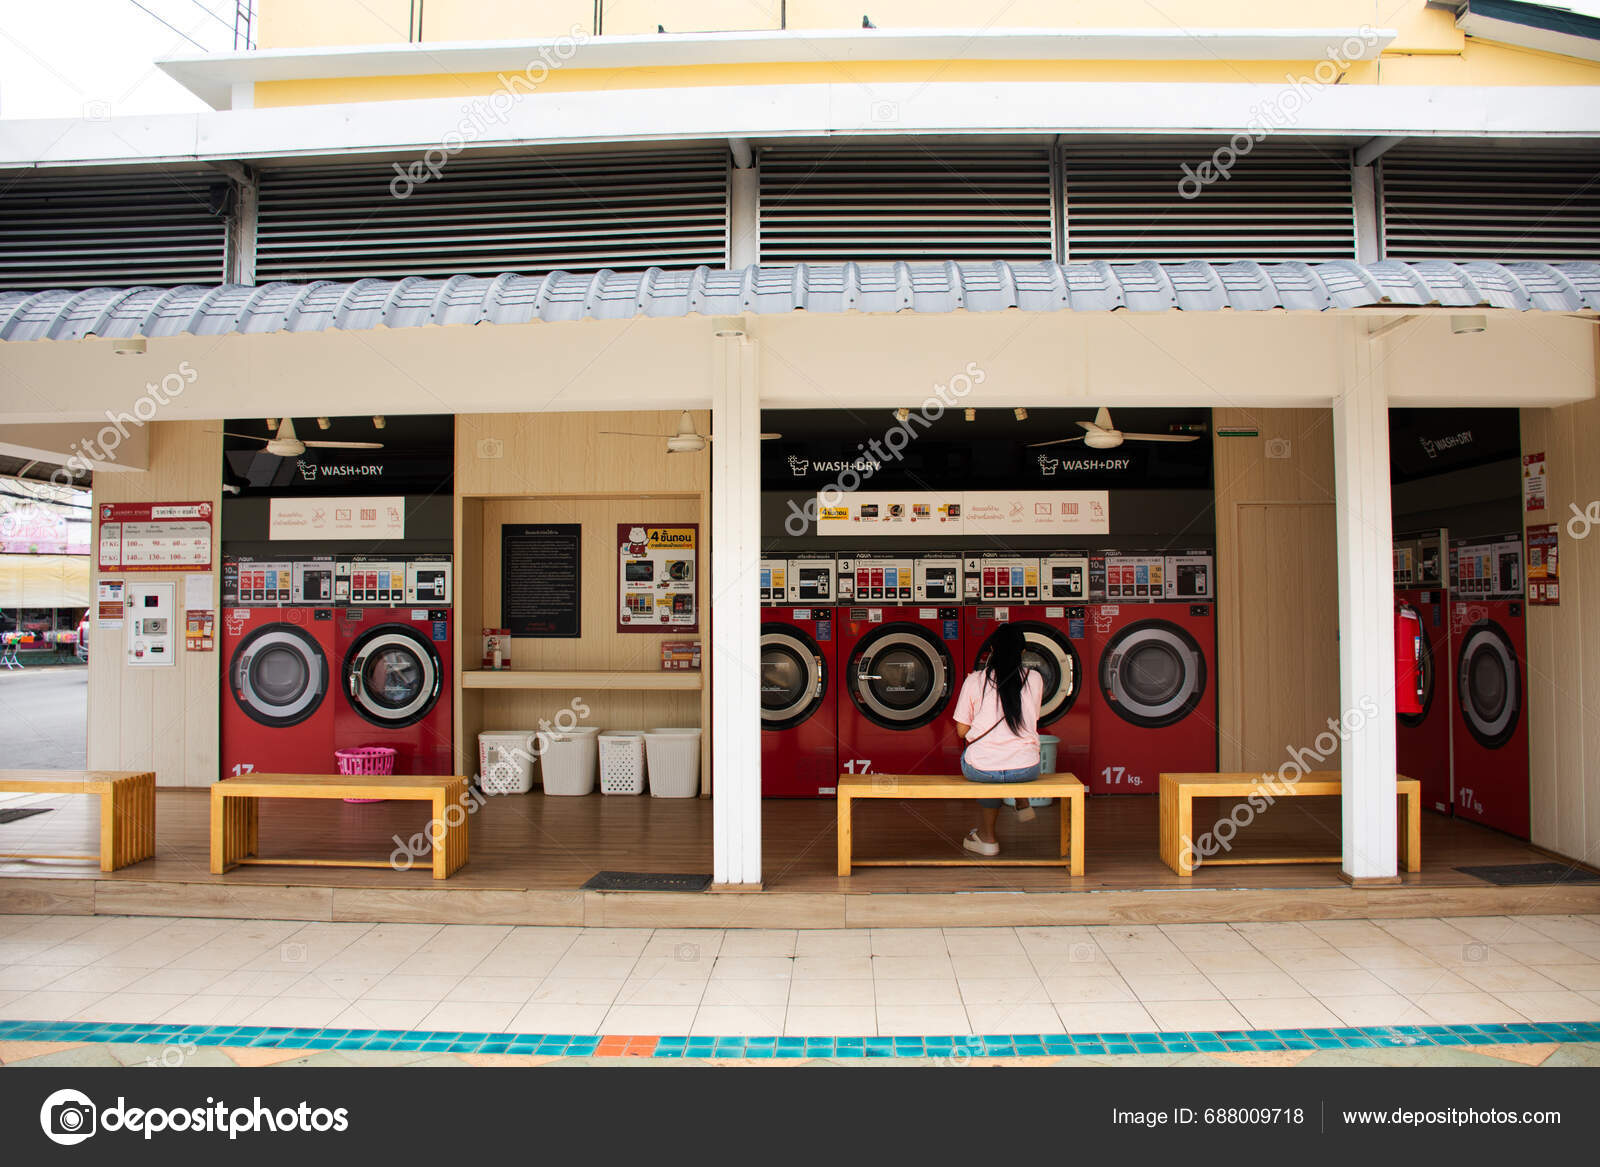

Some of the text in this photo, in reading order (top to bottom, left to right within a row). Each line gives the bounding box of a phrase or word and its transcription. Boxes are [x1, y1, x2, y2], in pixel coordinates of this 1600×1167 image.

[1434, 430, 1473, 450] WASH+DRY
[812, 461, 881, 472] WASH+DRY
[1062, 459, 1130, 470] WASH+DRY
[320, 465, 384, 476] WASH+DRY
[650, 530, 659, 542] 4
[842, 561, 849, 570] 3
[969, 560, 976, 569] 4
[225, 580, 233, 588] 17
[232, 763, 254, 776] 17
[843, 759, 872, 774] 17
[1101, 767, 1143, 785] 17 kg.
[1460, 787, 1473, 808] 17
